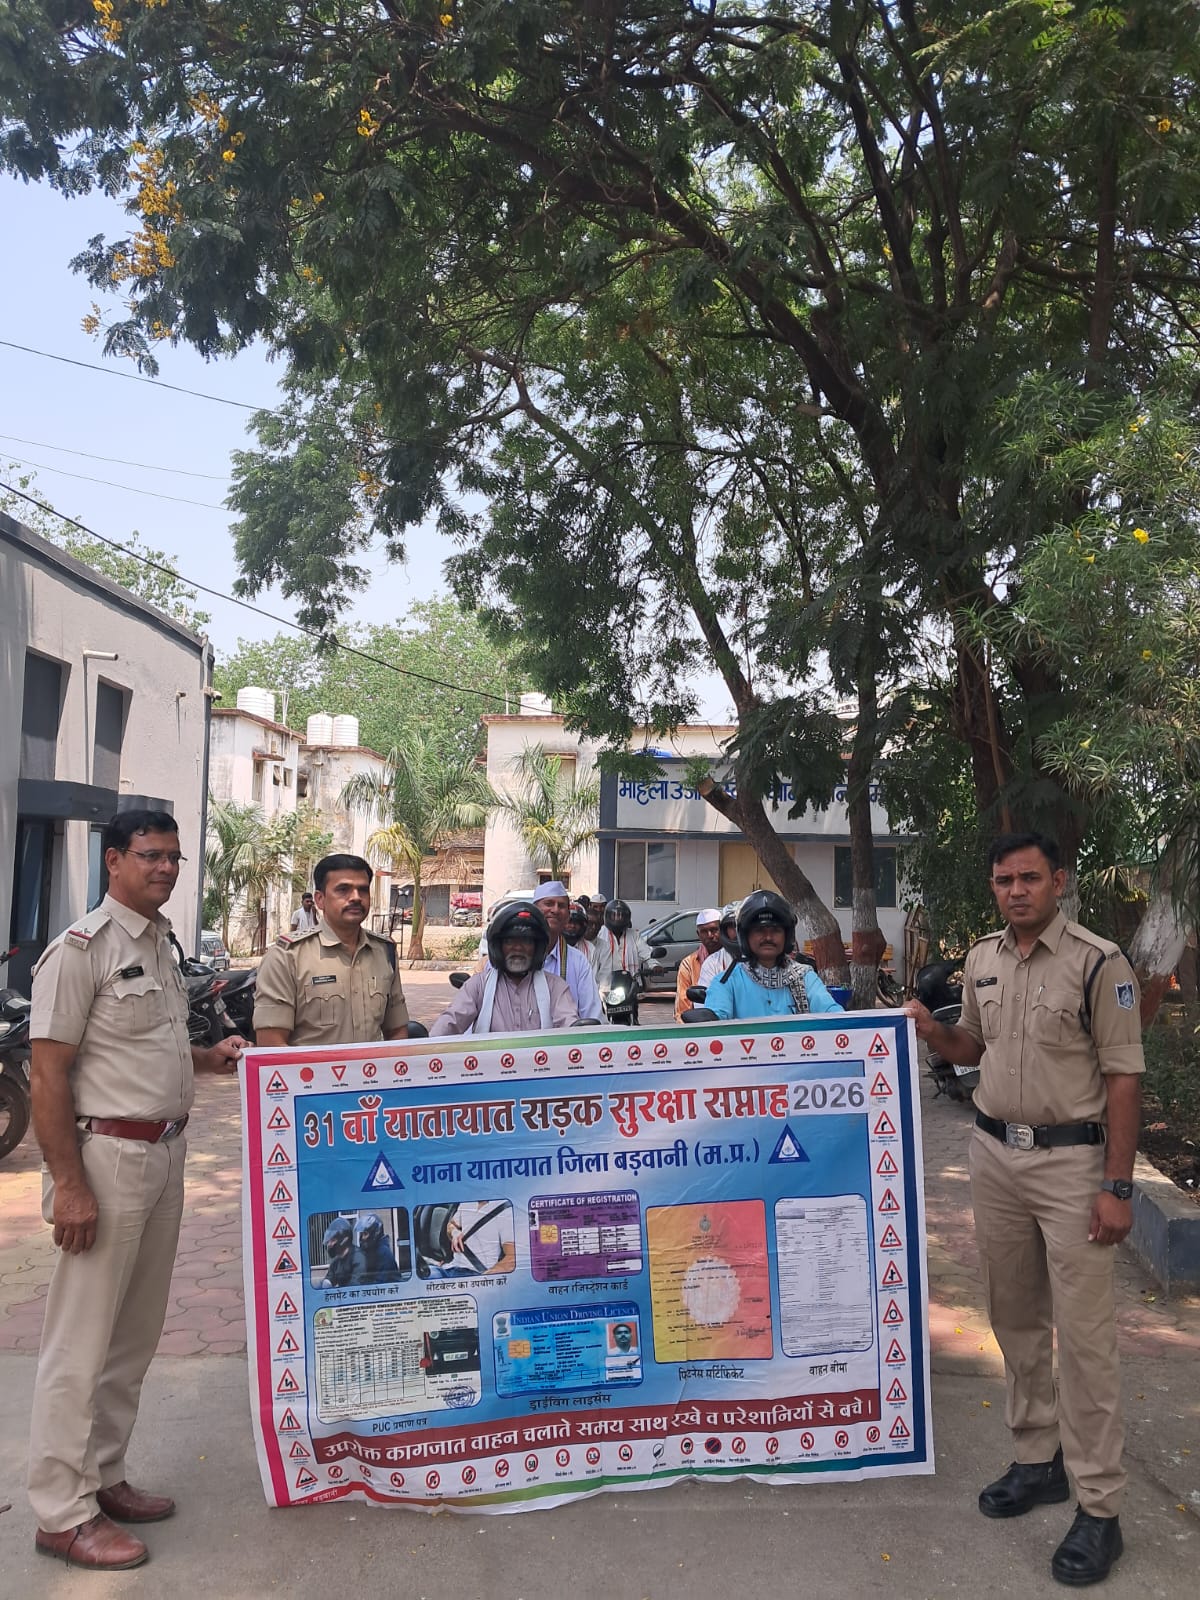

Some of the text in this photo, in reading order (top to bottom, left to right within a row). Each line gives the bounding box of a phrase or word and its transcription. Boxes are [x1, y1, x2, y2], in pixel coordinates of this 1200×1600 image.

[304, 1111, 334, 1147] 31
[341, 1095, 381, 1143] वाँ
[385, 1100, 515, 1141] यातायात
[521, 1093, 602, 1136] सड़क
[609, 1089, 696, 1137] सुरक्षा
[793, 1082, 865, 1110] 2026
[411, 1162, 462, 1185] थाना
[467, 1156, 552, 1181] यातायात
[558, 1146, 608, 1175] जिला
[614, 1139, 688, 1176] बड़वानी
[530, 1194, 637, 1208] CERTIFICATE OF REGISTRATION
[457, 1281, 468, 1289] का
[471, 1277, 494, 1288] उपयोग
[548, 1285, 569, 1295] वाहन
[611, 1279, 629, 1291] कार्ड
[349, 1290, 360, 1298] का
[361, 1286, 386, 1297] उपयोग
[512, 1314, 540, 1325] INDIAN
[542, 1311, 570, 1322] UNION
[570, 1309, 602, 1320] DRIVING
[809, 1360, 848, 1377] वाहन बीमा
[372, 1417, 428, 1433] PUC प्रमाण पत्र
[386, 1438, 465, 1462] कागजात
[470, 1430, 519, 1451] वाहन
[522, 1418, 571, 1443] चलाते
[575, 1419, 624, 1438] समय
[629, 1416, 668, 1432] साथ
[671, 1406, 701, 1427] रखे
[706, 1412, 718, 1426] व
[723, 1400, 814, 1427] परेशानियों
[818, 1399, 834, 1419] से
